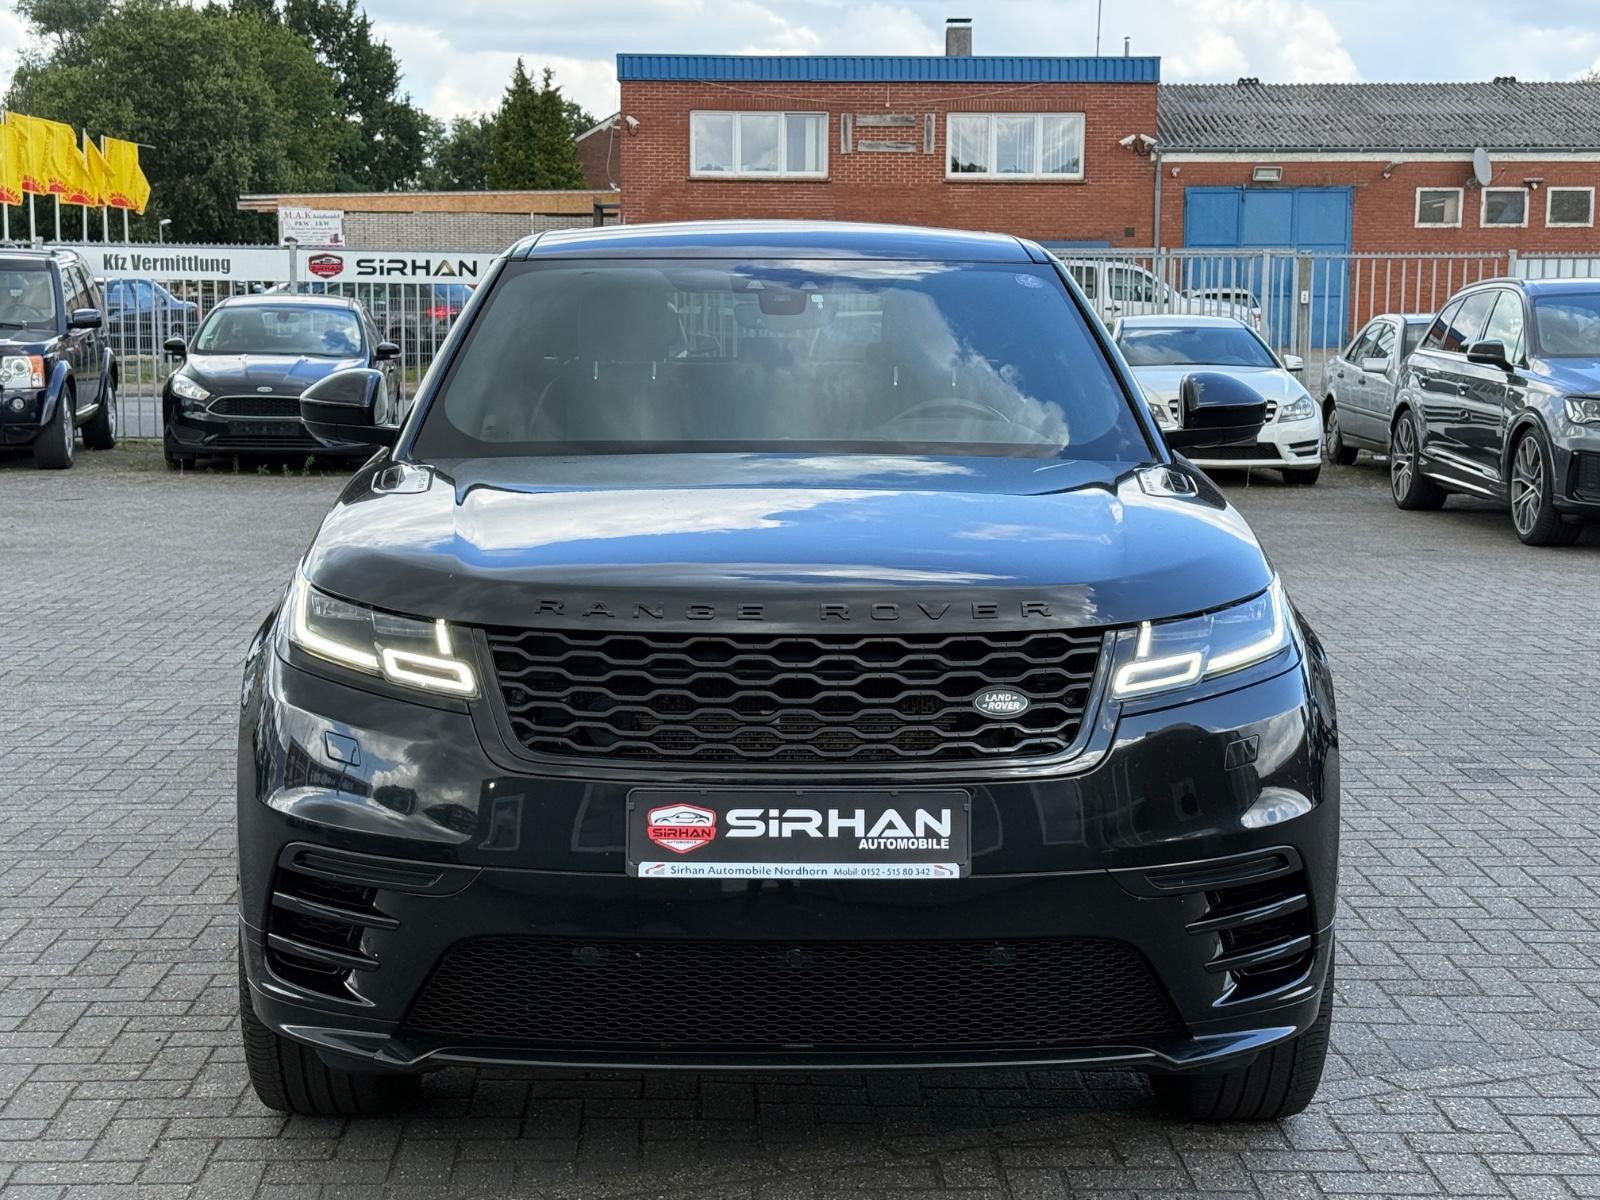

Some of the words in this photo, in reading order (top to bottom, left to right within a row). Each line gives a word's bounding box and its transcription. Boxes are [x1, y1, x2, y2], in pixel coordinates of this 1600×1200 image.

[103, 254, 128, 270] Kfz
[131, 254, 231, 274] Vermittlung
[534, 599, 764, 621] RANGE
[820, 600, 1052, 621] ROVER
[858, 838, 950, 850] AUTOMOBILE
[670, 866, 705, 875] Sirhan
[708, 866, 773, 876] Automobile
[774, 866, 828, 876] Nordhorn
[833, 868, 860, 876] Mobil:
[902, 868, 914, 876] 80
[915, 868, 931, 876] 342
